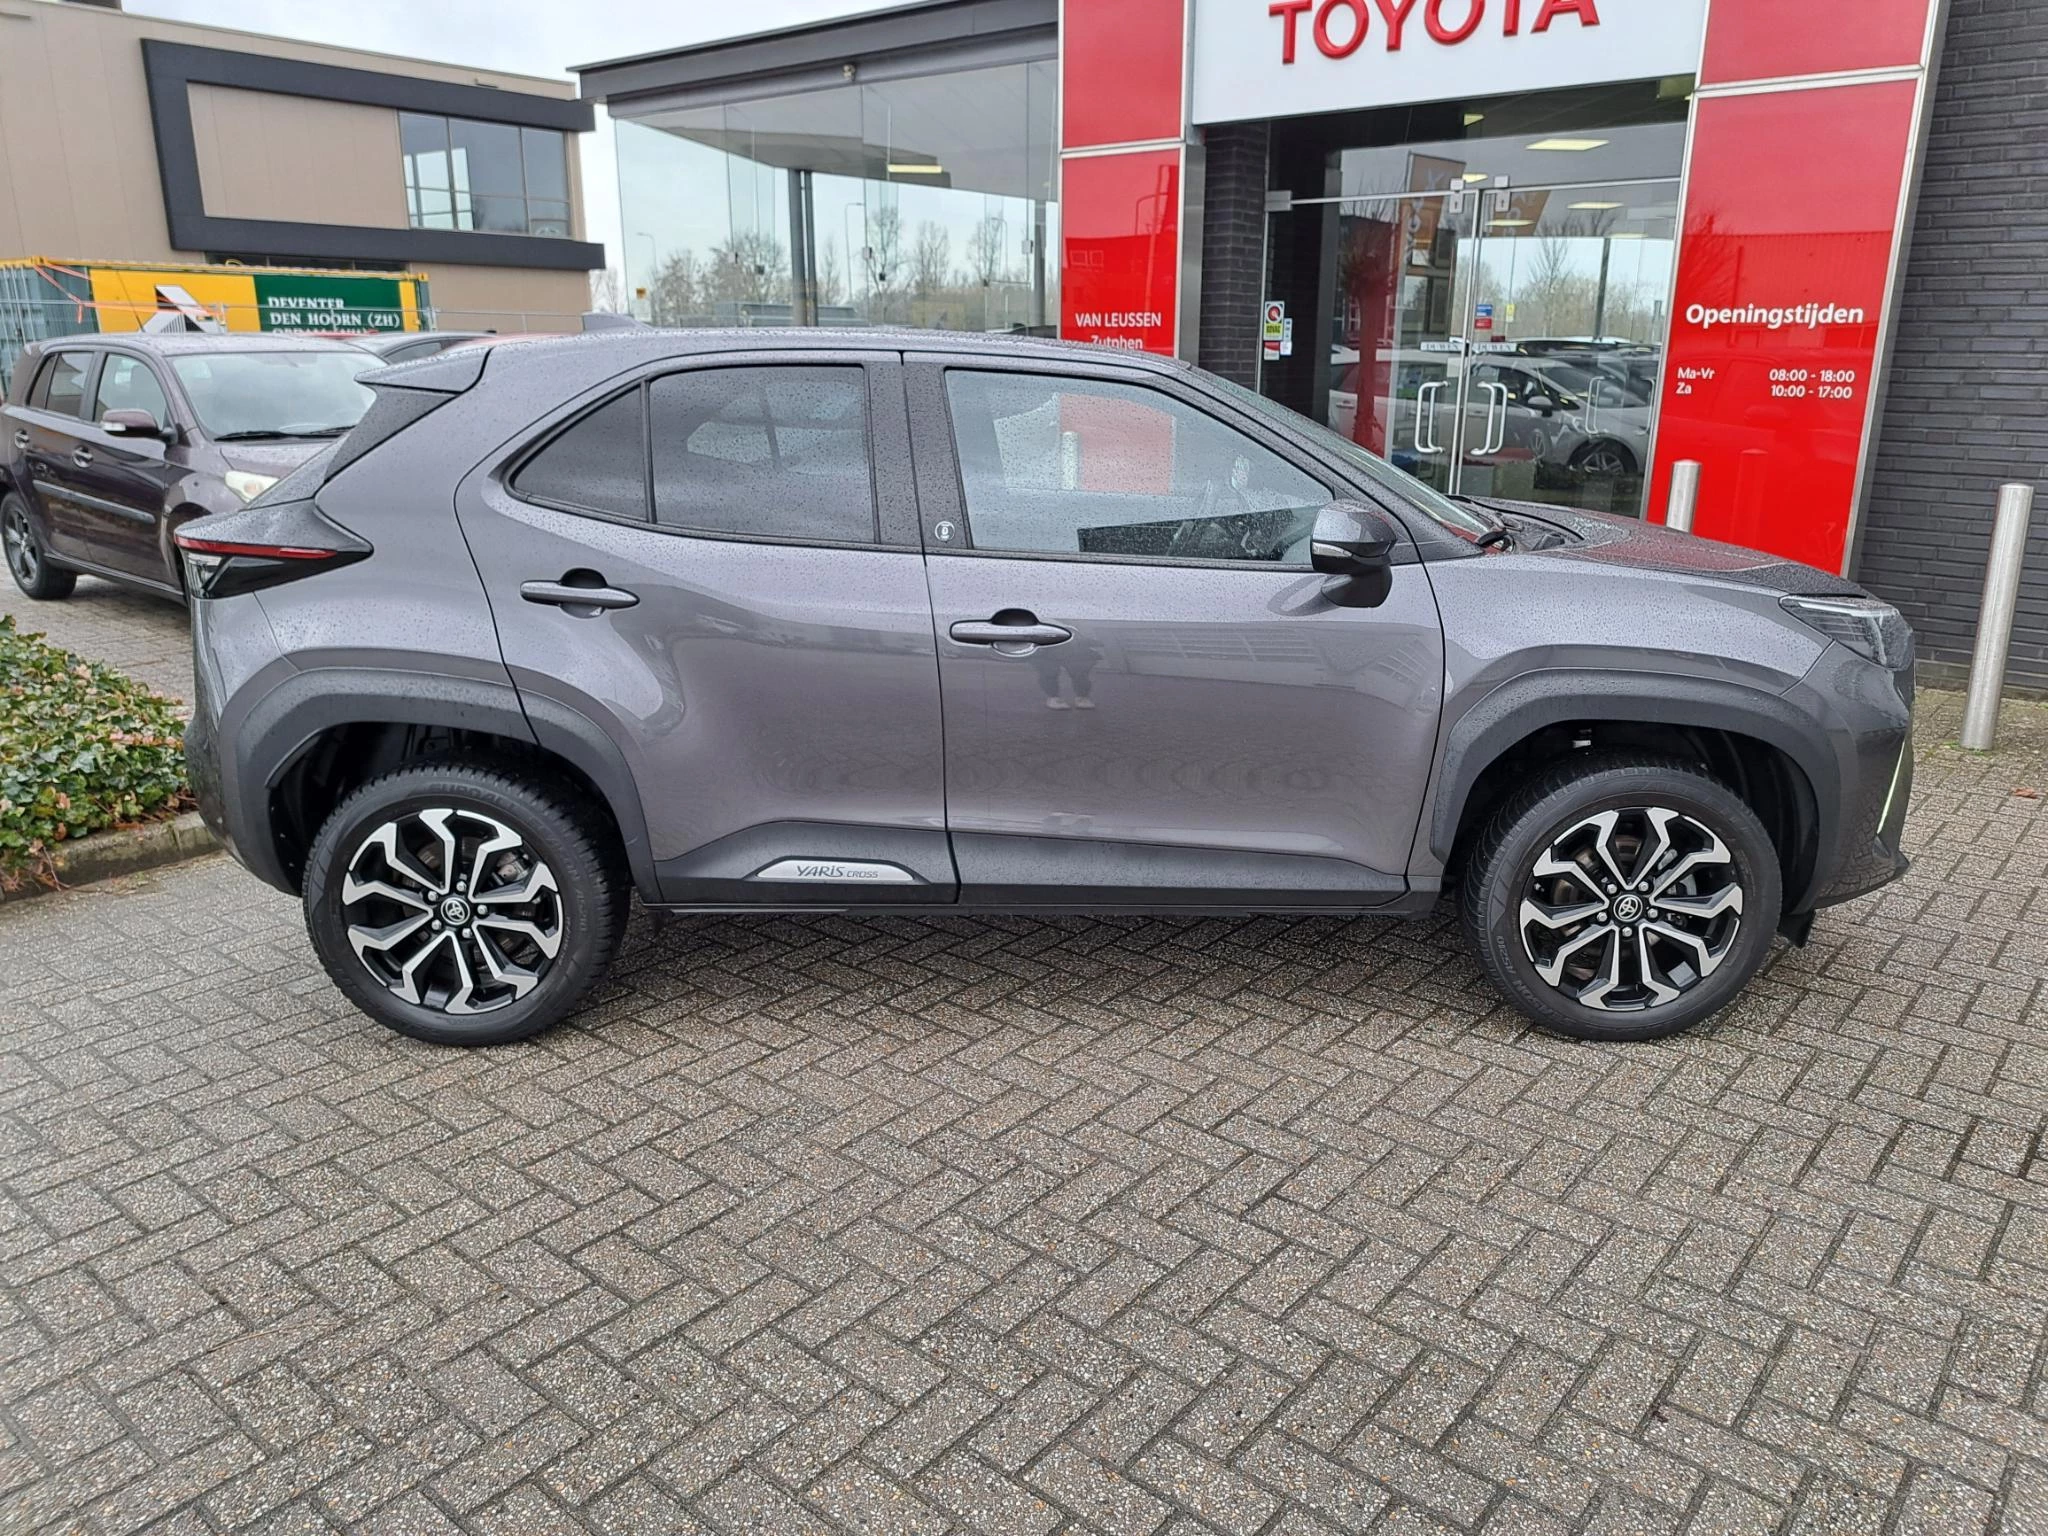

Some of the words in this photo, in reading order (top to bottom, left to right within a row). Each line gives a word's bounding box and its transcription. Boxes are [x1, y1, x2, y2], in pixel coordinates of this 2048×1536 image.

[1269, 0, 1601, 65] TOYOTA
[267, 296, 345, 309] DEVENTER
[270, 312, 302, 325] DEN
[308, 312, 362, 327] HOORN
[367, 312, 400, 328] (ZH)
[1075, 312, 1102, 327] VAN
[1104, 312, 1162, 327] LEUSSEN
[1686, 303, 1864, 329] Openingstijden
[1677, 367, 1715, 380] Ma-Vr
[1769, 368, 1808, 382] 08:00
[1819, 369, 1855, 383] 18:00
[1675, 382, 1692, 395] Za
[1770, 384, 1806, 398] 10:00
[1817, 385, 1853, 399] 17:00
[797, 865, 845, 877] YARIS
[846, 870, 879, 878] CROSS
